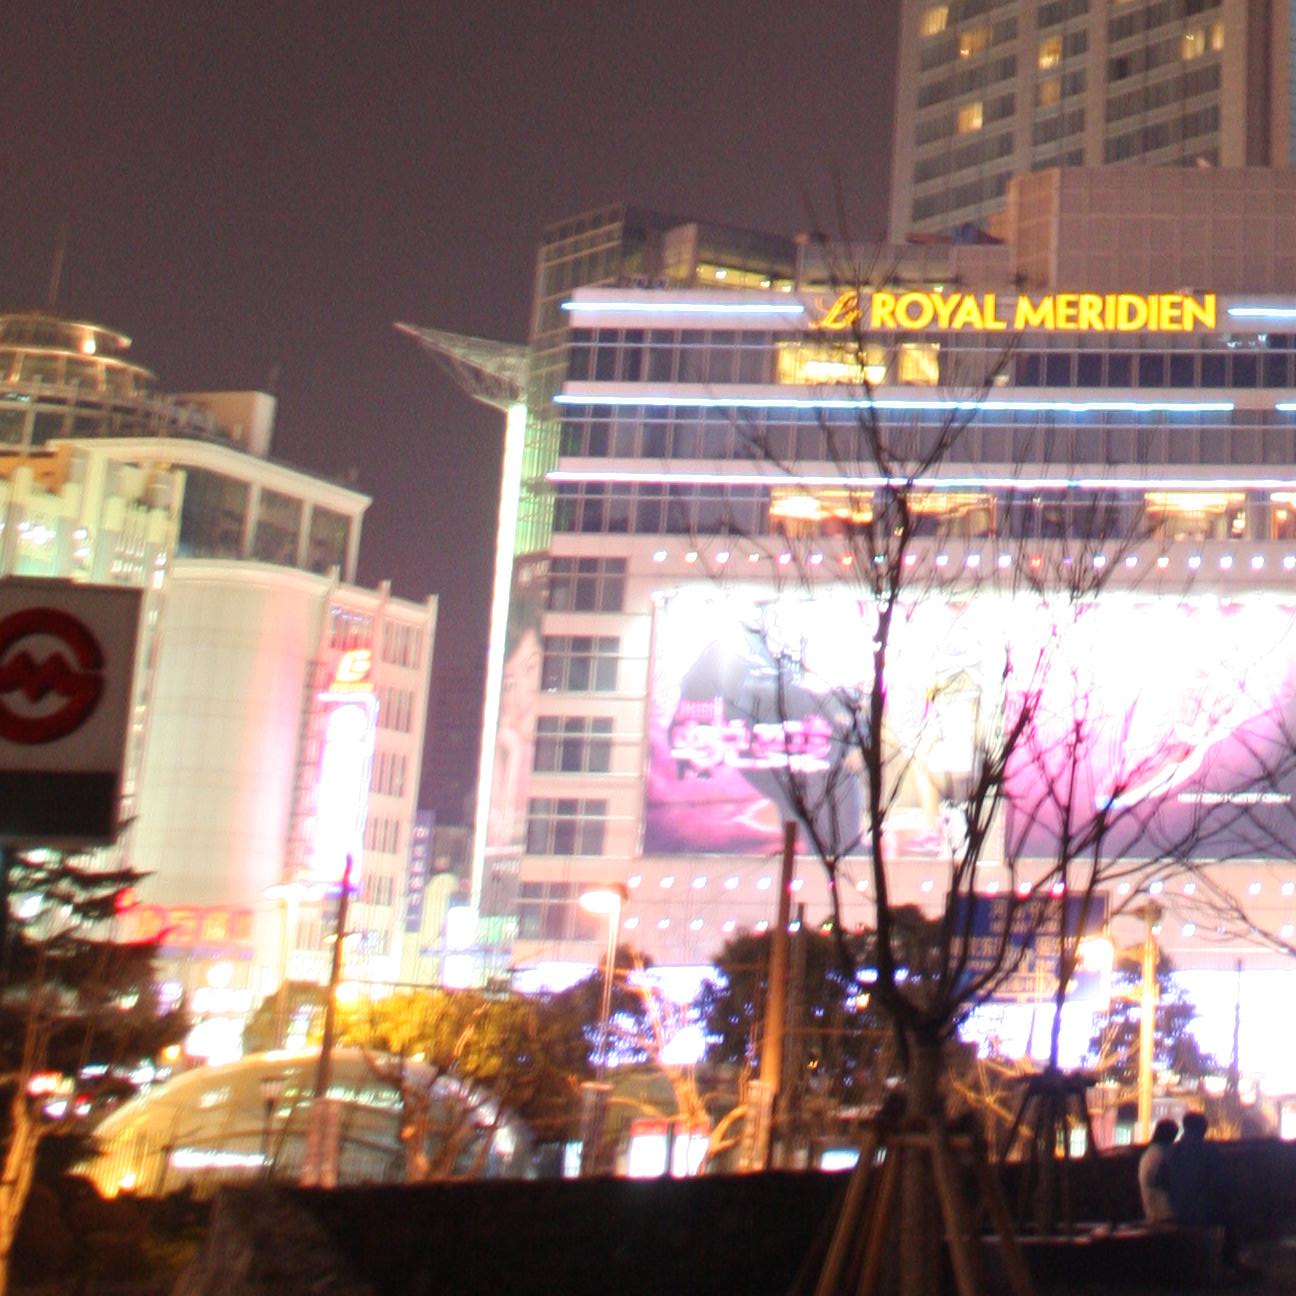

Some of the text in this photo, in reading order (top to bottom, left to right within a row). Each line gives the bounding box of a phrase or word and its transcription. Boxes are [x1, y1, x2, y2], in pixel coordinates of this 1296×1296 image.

[809, 289, 1217, 332] Le ROYAL MERIDIEN
